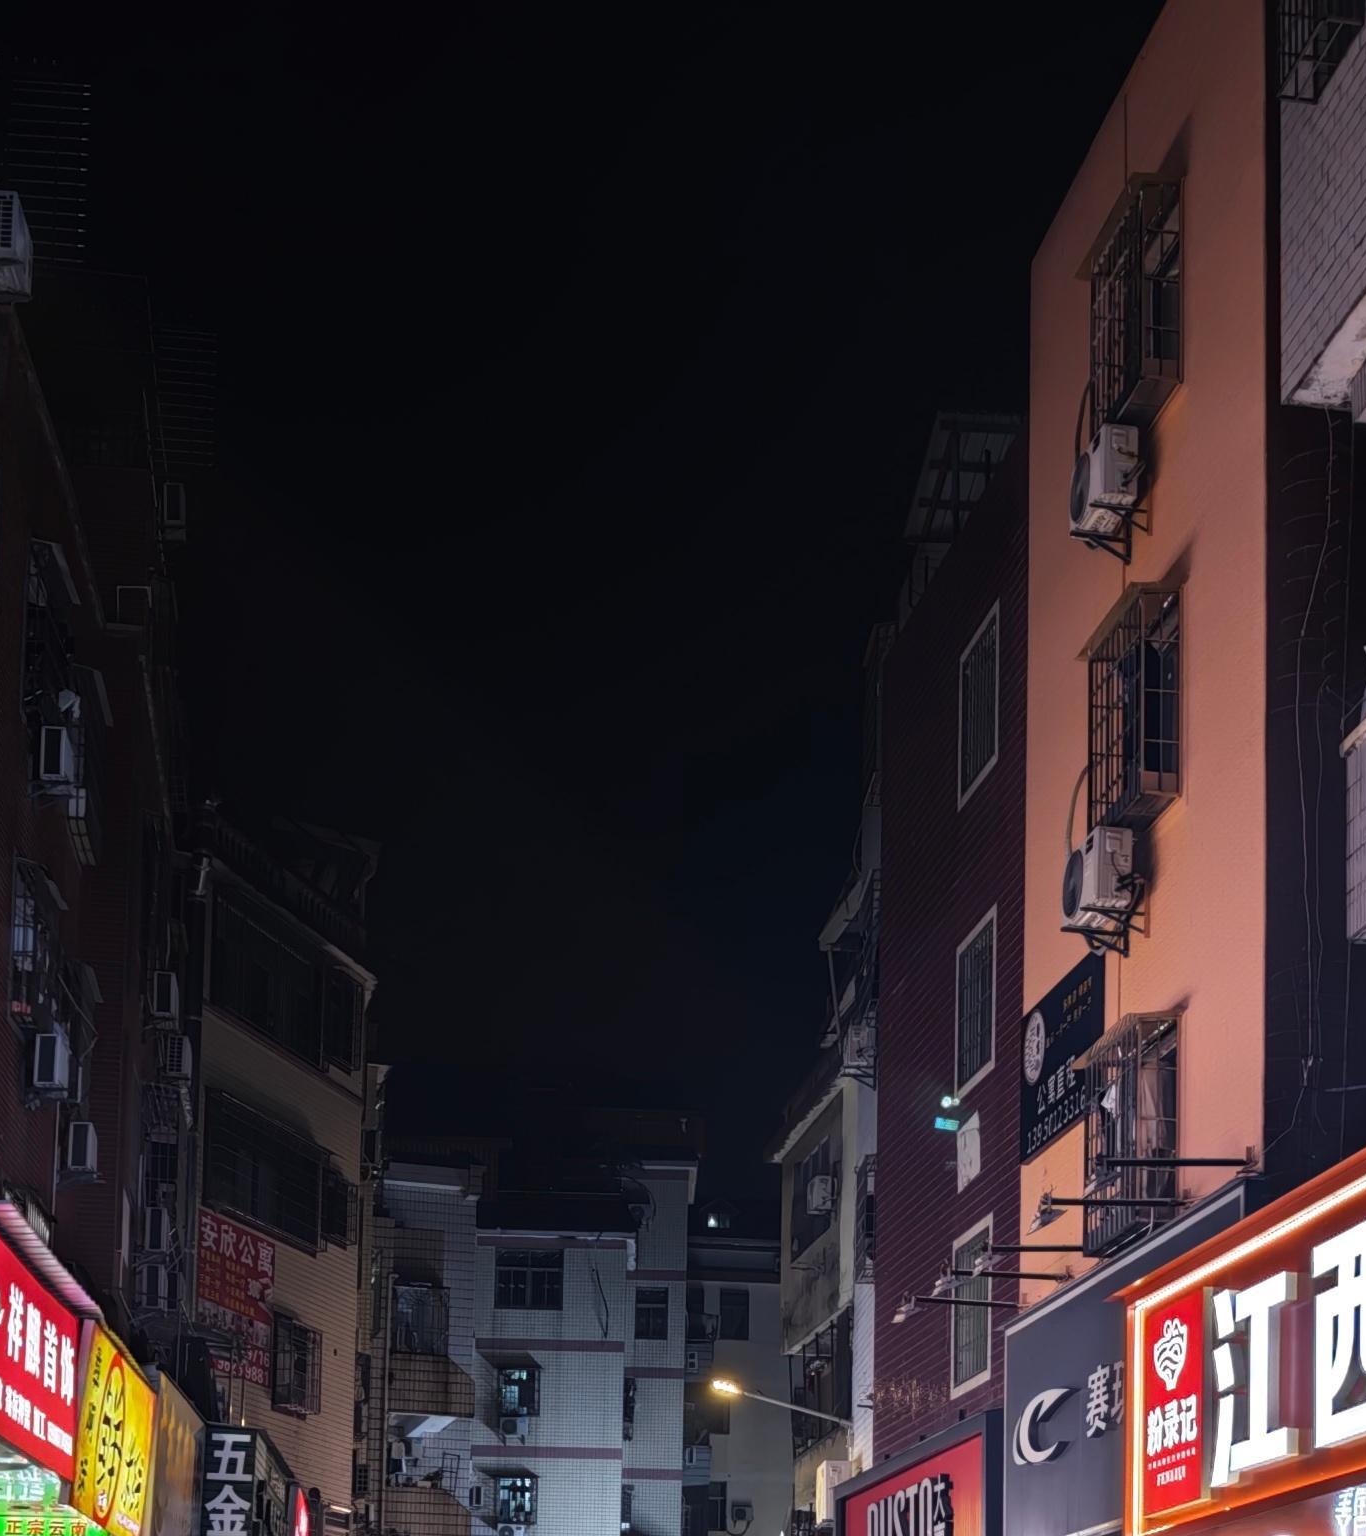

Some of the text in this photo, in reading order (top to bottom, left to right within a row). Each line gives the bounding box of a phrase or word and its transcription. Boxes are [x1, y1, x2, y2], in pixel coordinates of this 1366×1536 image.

[200, 1215, 274, 1278] 安欣公寓
[7, 1283, 75, 1407] 祥麒首饰
[1146, 1392, 1198, 1457] 粉录记
